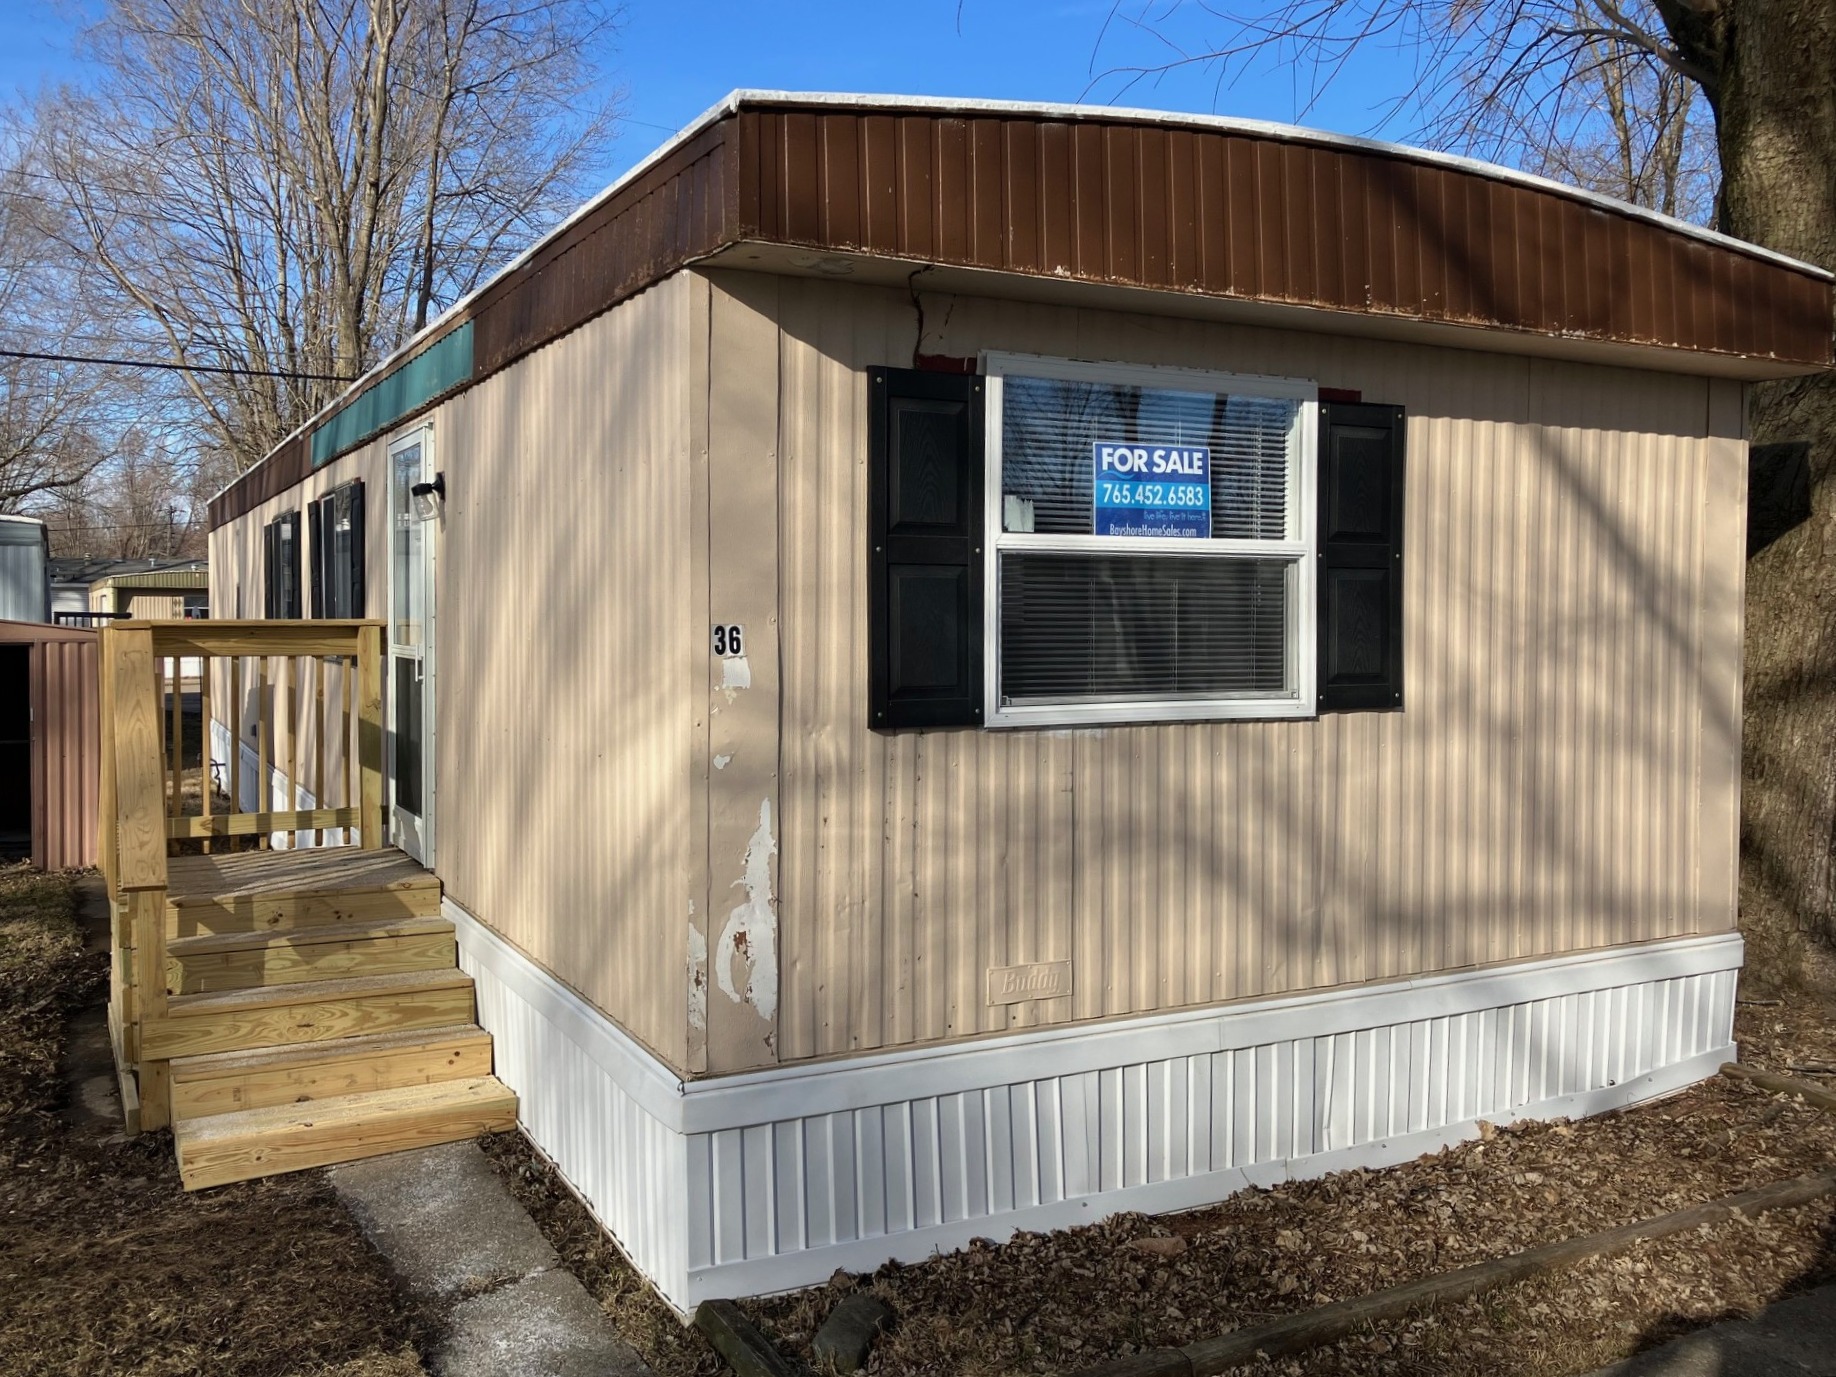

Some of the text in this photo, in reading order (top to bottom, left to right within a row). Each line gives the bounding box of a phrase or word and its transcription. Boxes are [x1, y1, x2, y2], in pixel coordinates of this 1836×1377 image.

[1101, 447, 1203, 475] FOR SALE
[1103, 483, 1203, 506] 765.452.6583
[1109, 523, 1197, 537] BayshoreHomeSales.com
[714, 625, 741, 656] 36
[1001, 966, 1061, 995] Buddy
